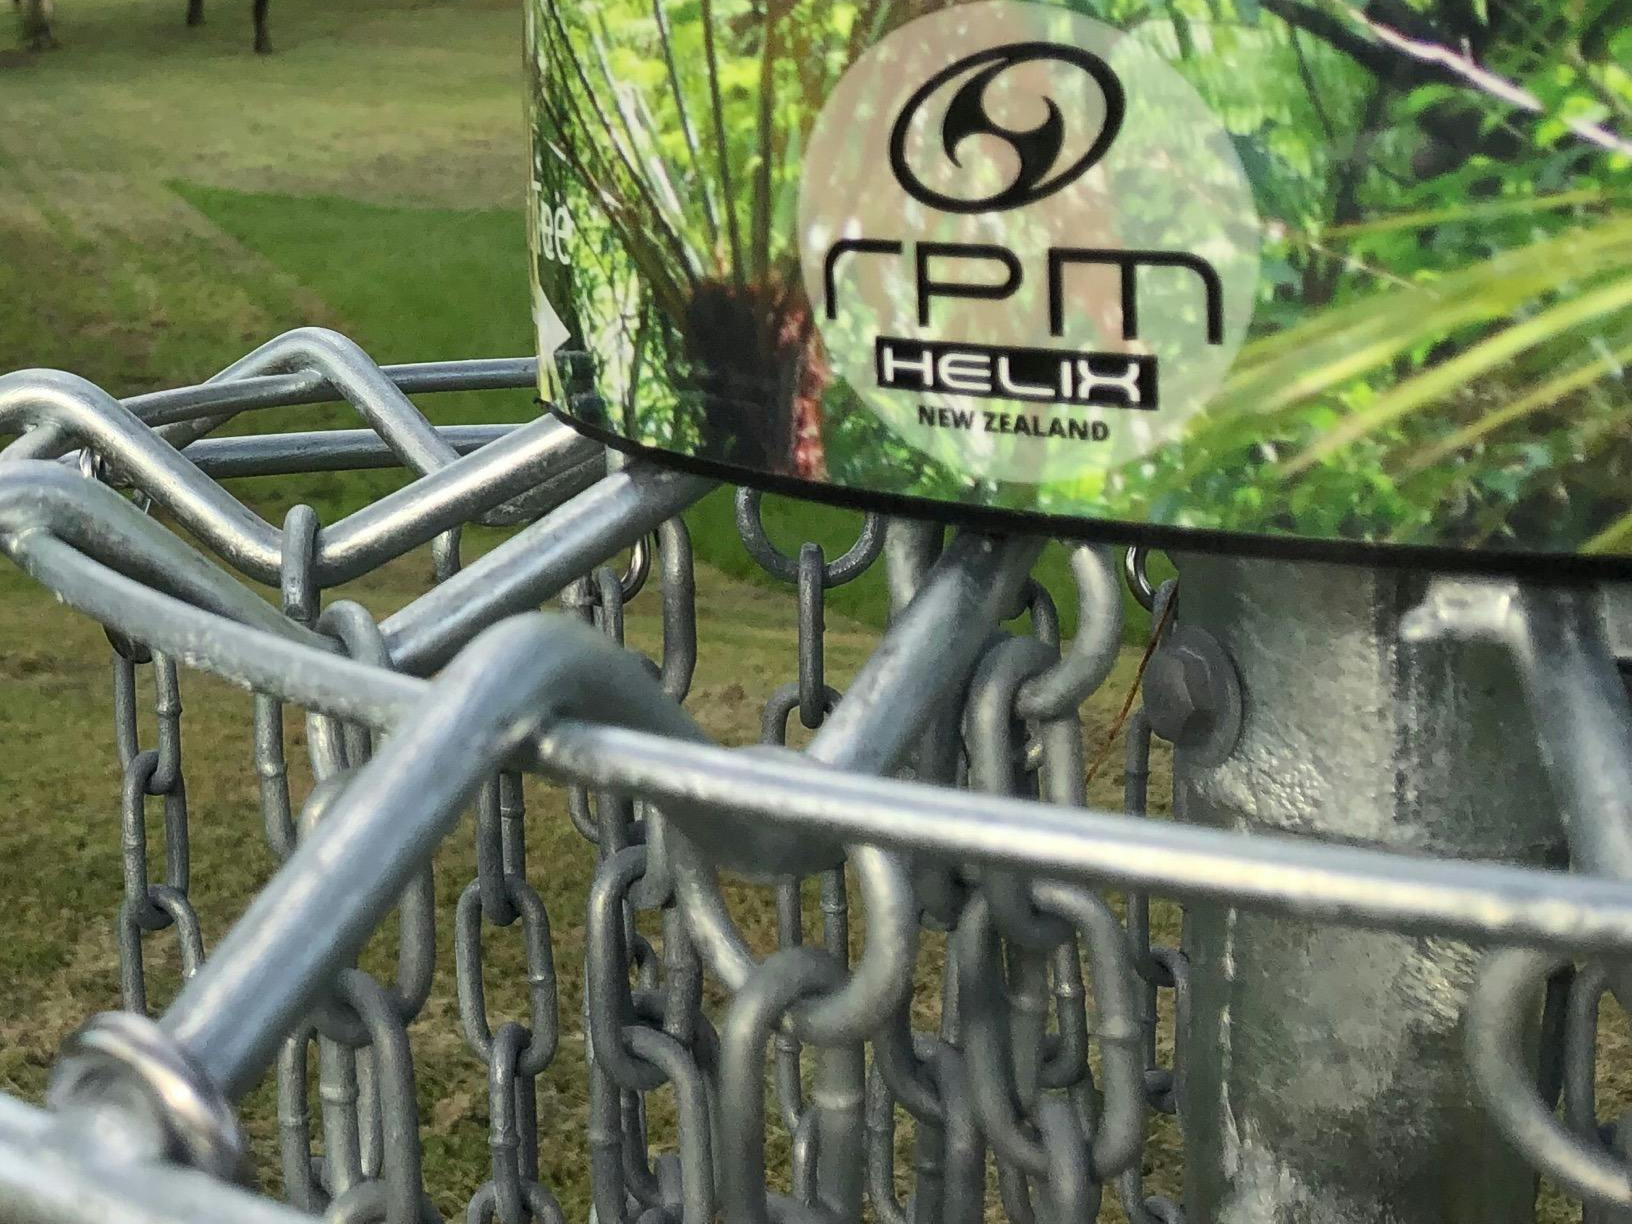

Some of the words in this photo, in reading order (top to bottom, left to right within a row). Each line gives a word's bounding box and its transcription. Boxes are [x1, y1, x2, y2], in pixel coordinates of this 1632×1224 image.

[882, 345, 1142, 404] HELIX
[917, 405, 974, 431] NEW
[983, 411, 1111, 443] ZEALAND
